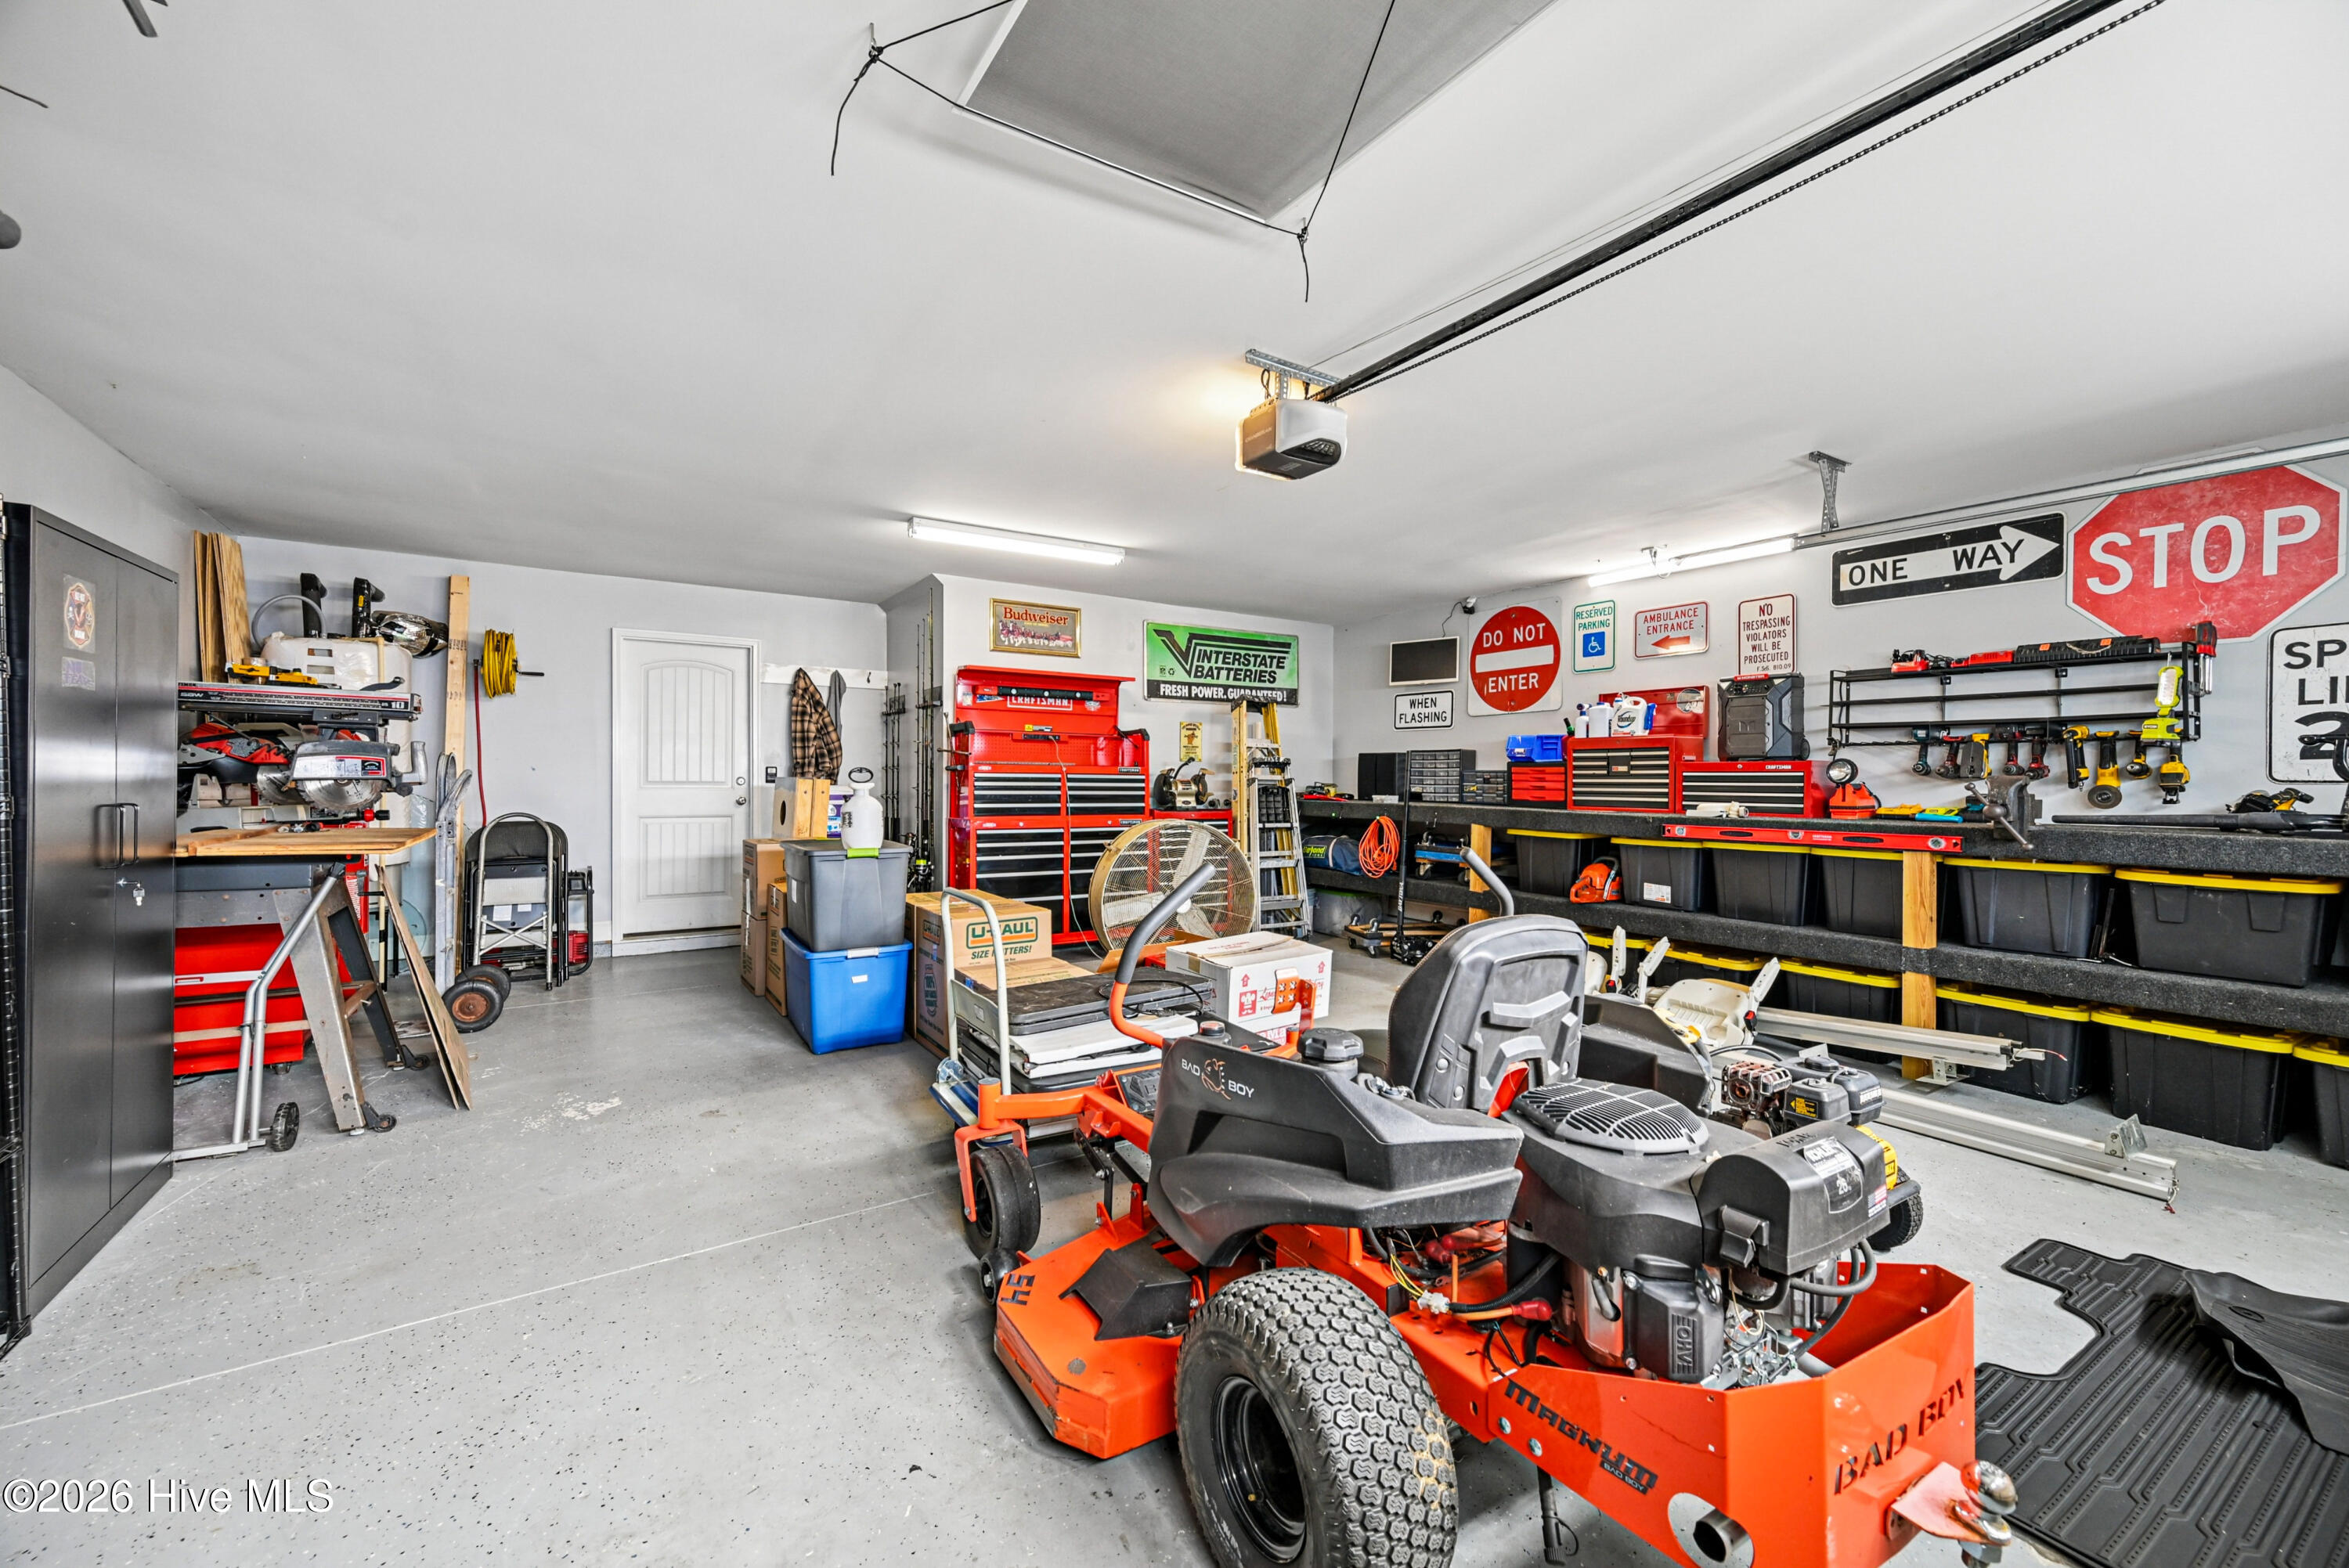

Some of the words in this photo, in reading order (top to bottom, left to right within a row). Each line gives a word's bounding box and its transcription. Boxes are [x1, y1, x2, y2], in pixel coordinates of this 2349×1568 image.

[2086, 505, 2322, 595] STOP
[1848, 557, 1908, 587] ONE
[1952, 539, 2025, 571] WAY
[1003, 606, 1069, 625] Budweiser
[1575, 606, 1612, 620] RESERVED
[1644, 607, 1698, 624] AMBULANCE
[1759, 604, 1773, 617] NO
[1579, 618, 1610, 631] PARKING
[1647, 620, 1694, 635] ENTRANCE
[1743, 615, 1791, 632] TRESPASSING
[1483, 630, 1503, 647] DO
[1514, 623, 1546, 643] NOT
[1746, 629, 1787, 642] VIOLATORS
[1751, 642, 1768, 653] WILL
[1772, 640, 1781, 651] BE
[1196, 648, 1287, 670] INTERSTATE
[1744, 651, 1788, 665] PROSECUTED
[1193, 665, 1277, 684] BATTERIES
[1488, 672, 1539, 693] ENTER
[1160, 683, 1189, 697] FRESH
[1192, 687, 1227, 700] POWER.
[2298, 676, 2349, 705] LI
[1409, 697, 1437, 709] WHEN
[1399, 711, 1447, 724] FLASHING
[971, 950, 990, 960] SIZE
[991, 945, 1032, 957] TTERS!
[1182, 1058, 1200, 1076] BAD
[1228, 1080, 1254, 1098] BOY
[1505, 1379, 1658, 1489] MAGNUM
[1835, 1423, 1907, 1496] BAD
[1918, 1379, 1964, 1436] BOY
[1604, 1462, 1623, 1479] BAD
[1625, 1475, 1645, 1491] BOY
